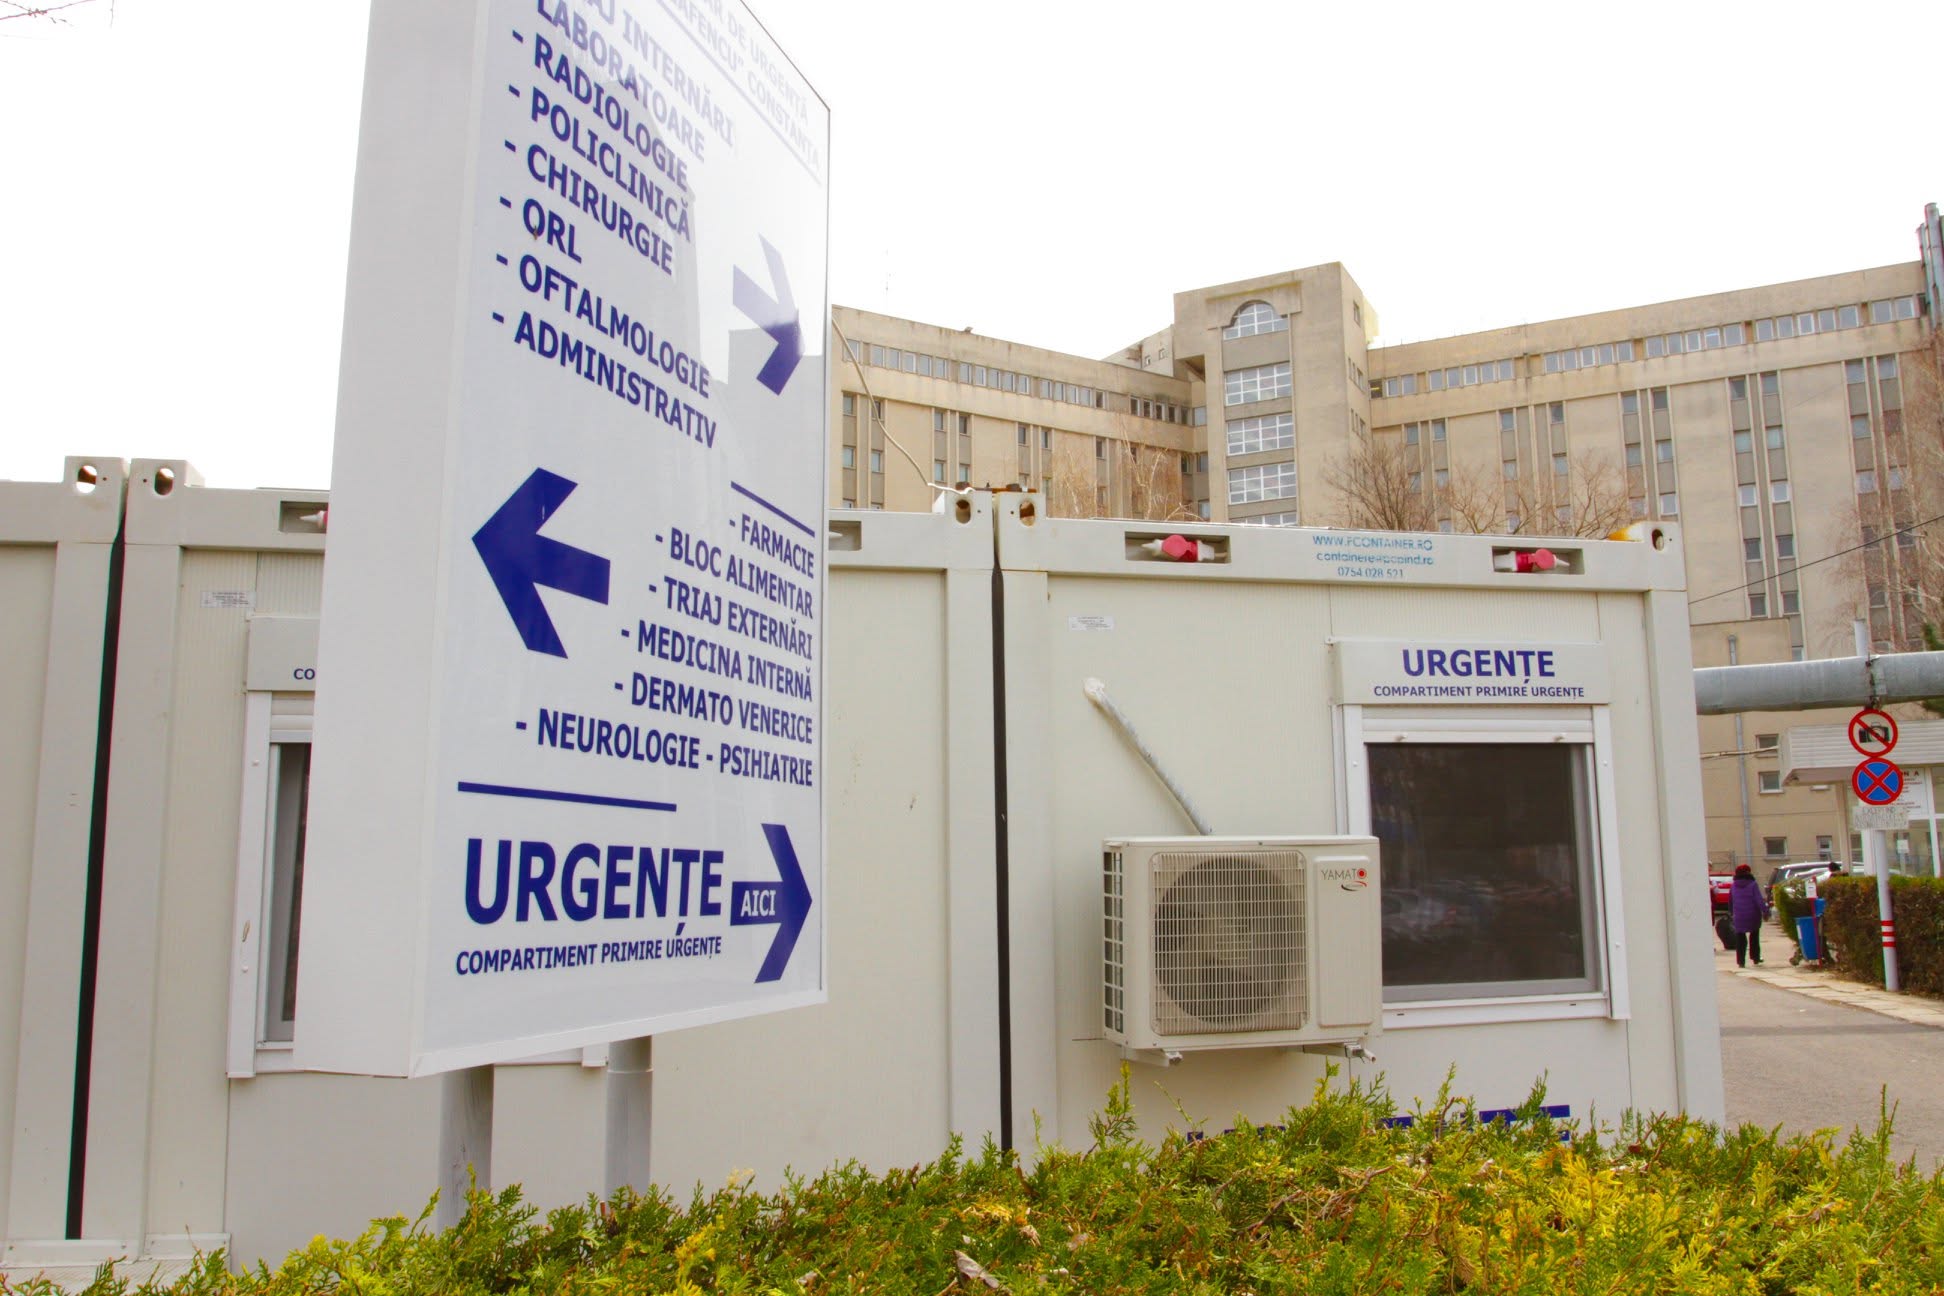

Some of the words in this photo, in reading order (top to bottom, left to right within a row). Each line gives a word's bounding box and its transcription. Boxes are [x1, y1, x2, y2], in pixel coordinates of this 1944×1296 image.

[534, 32, 688, 193] RADIOLOGIE
[622, 8, 734, 148] INTERNĂRI
[531, 86, 691, 242] POLICLINICĂ
[523, 198, 582, 263] ORL
[527, 143, 673, 276] CHIRURGIE
[520, 254, 709, 399] OFTALMOLOGIE
[514, 311, 717, 449] ADMINISTRATIV
[670, 527, 722, 577] BLOC
[726, 554, 813, 620] ALIMENTAR
[742, 513, 814, 579] FARMACIE
[1337, 566, 1361, 577] 0754
[1365, 567, 1383, 578] 028
[664, 575, 722, 626] TRIAJ
[728, 601, 812, 660] EXTERNĂRI
[293, 668, 316, 680] CO
[638, 619, 742, 681] MEDICINA
[747, 654, 812, 702] INTERNĂ
[1374, 686, 1472, 697] COMPARTIMENT
[1476, 686, 1528, 698] PRIMIRE
[1531, 687, 1585, 700] URGENȚE
[1402, 649, 1556, 684] URGENȚE
[631, 671, 733, 726] DERMATO
[738, 699, 812, 744] VENERICE
[537, 708, 700, 769] NEUROLOGIE
[720, 743, 812, 787] PSIHIATRIE
[465, 838, 724, 936] URGENȚE
[740, 889, 777, 918] AICI
[1321, 867, 1368, 881] YAMATO
[456, 943, 597, 975] COMPARTIMENT
[601, 939, 662, 964] PRIMIRE
[666, 936, 722, 959] URGENȚE
